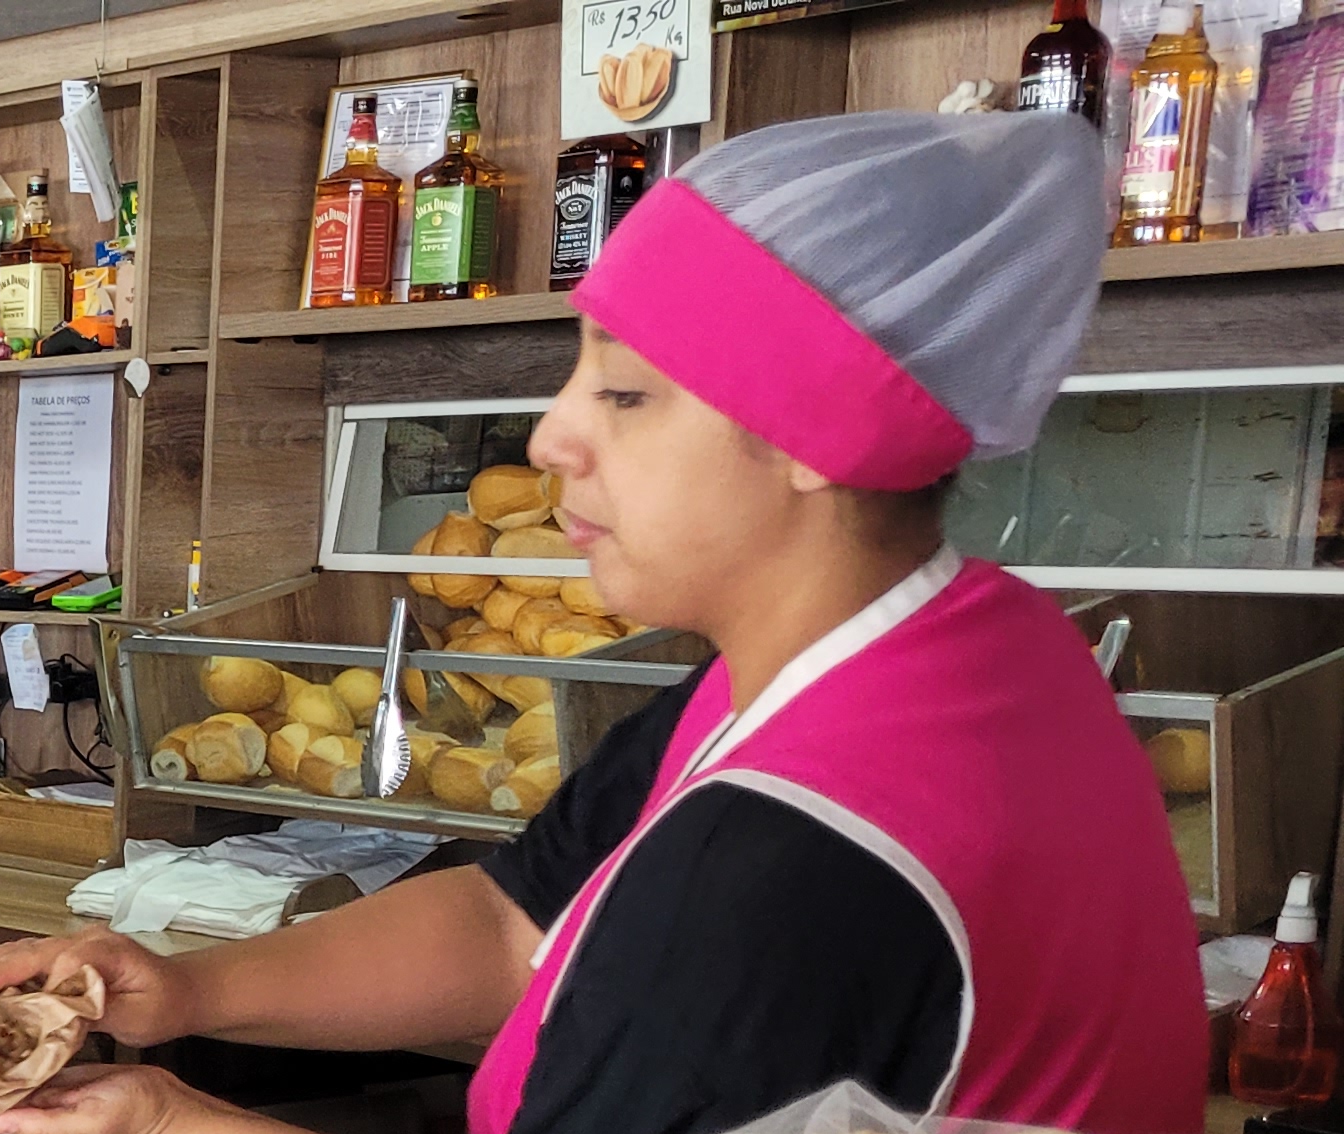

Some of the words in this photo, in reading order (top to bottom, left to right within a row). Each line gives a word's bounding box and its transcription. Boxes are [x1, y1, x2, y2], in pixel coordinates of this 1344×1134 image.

[722, 3, 743, 16] Rua
[744, 0, 770, 12] Nova
[606, 0, 676, 49] 13,50
[414, 201, 434, 221] JACK
[420, 243, 450, 253] APPLE
[31, 396, 55, 407] TABELA
[56, 396, 65, 406] DE
[66, 395, 91, 408] PREÇOS
